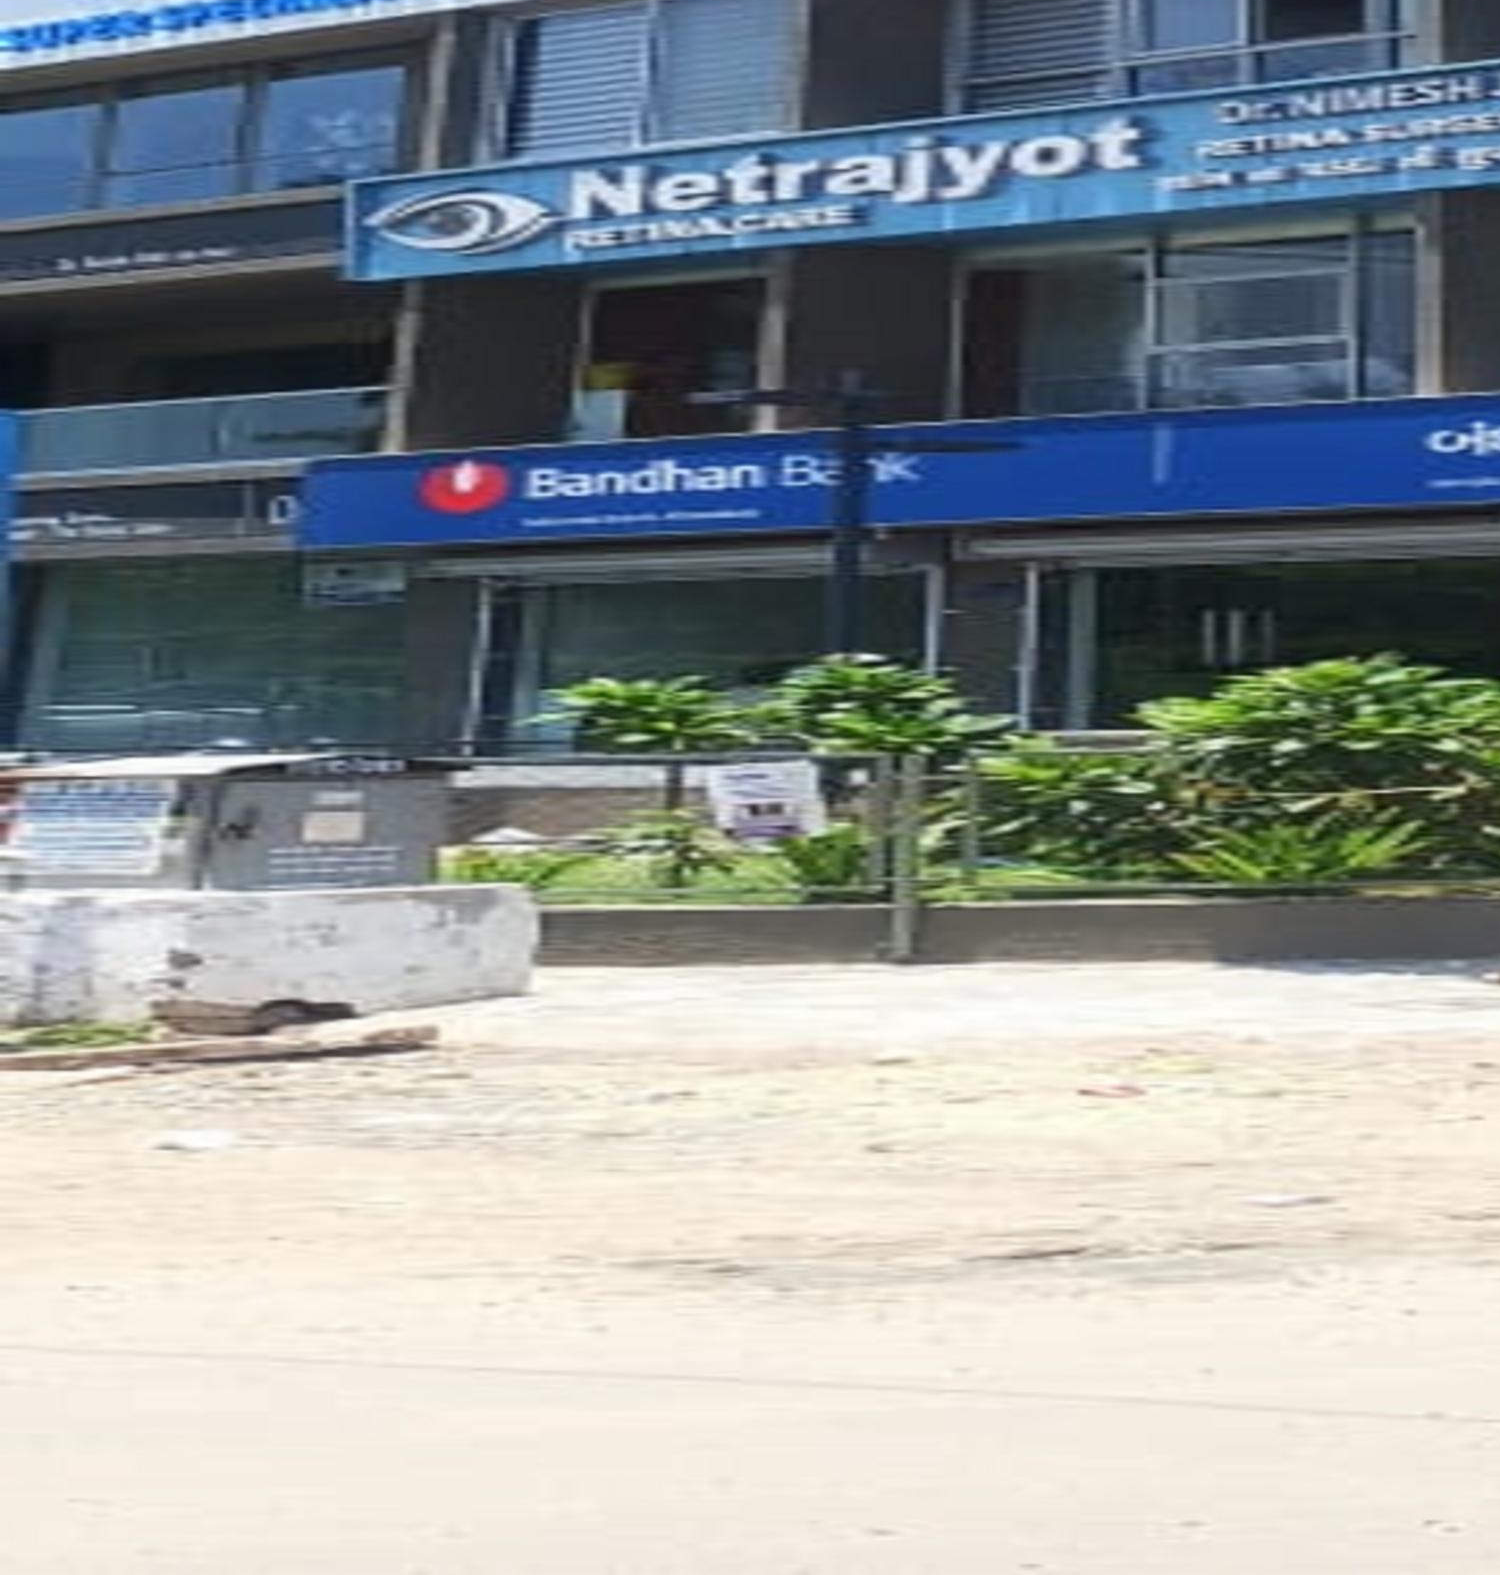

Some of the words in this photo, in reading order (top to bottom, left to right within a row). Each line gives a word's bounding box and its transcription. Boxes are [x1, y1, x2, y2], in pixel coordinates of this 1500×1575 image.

[1283, 74, 1482, 120] NIMESH
[1199, 127, 1362, 162] RETINA
[568, 119, 1147, 217] Netrajyot
[523, 459, 761, 500] Bandhan
